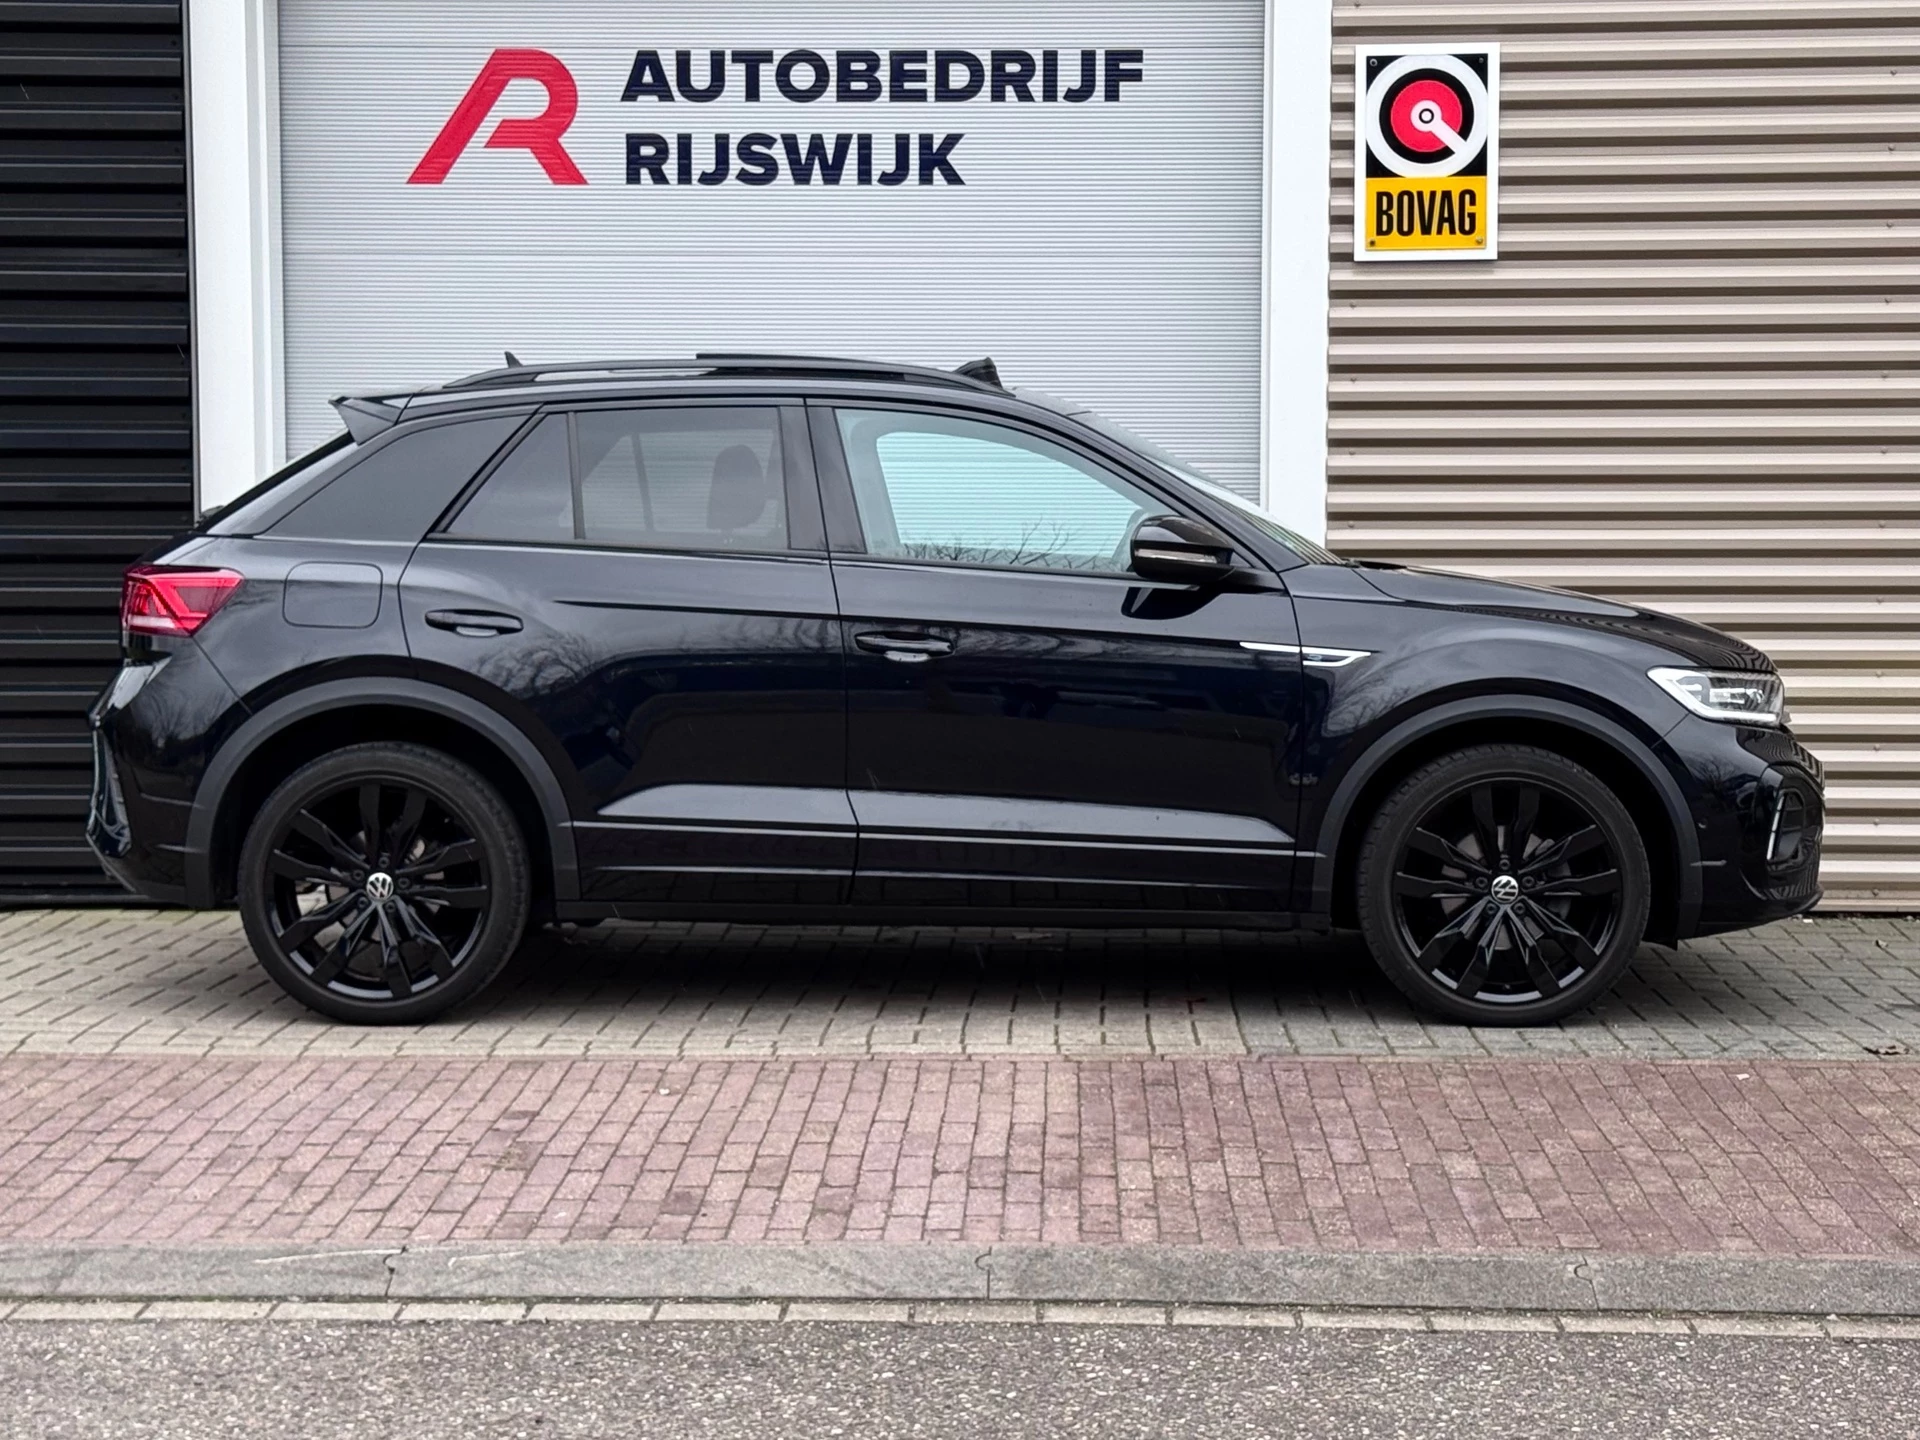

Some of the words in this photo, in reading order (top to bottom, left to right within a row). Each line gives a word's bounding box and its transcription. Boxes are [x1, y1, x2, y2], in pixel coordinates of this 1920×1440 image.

[621, 49, 1143, 103] AUTOBEDRIJF
[625, 132, 966, 186] RIJSWIJK
[1375, 188, 1477, 237] BOVAG
